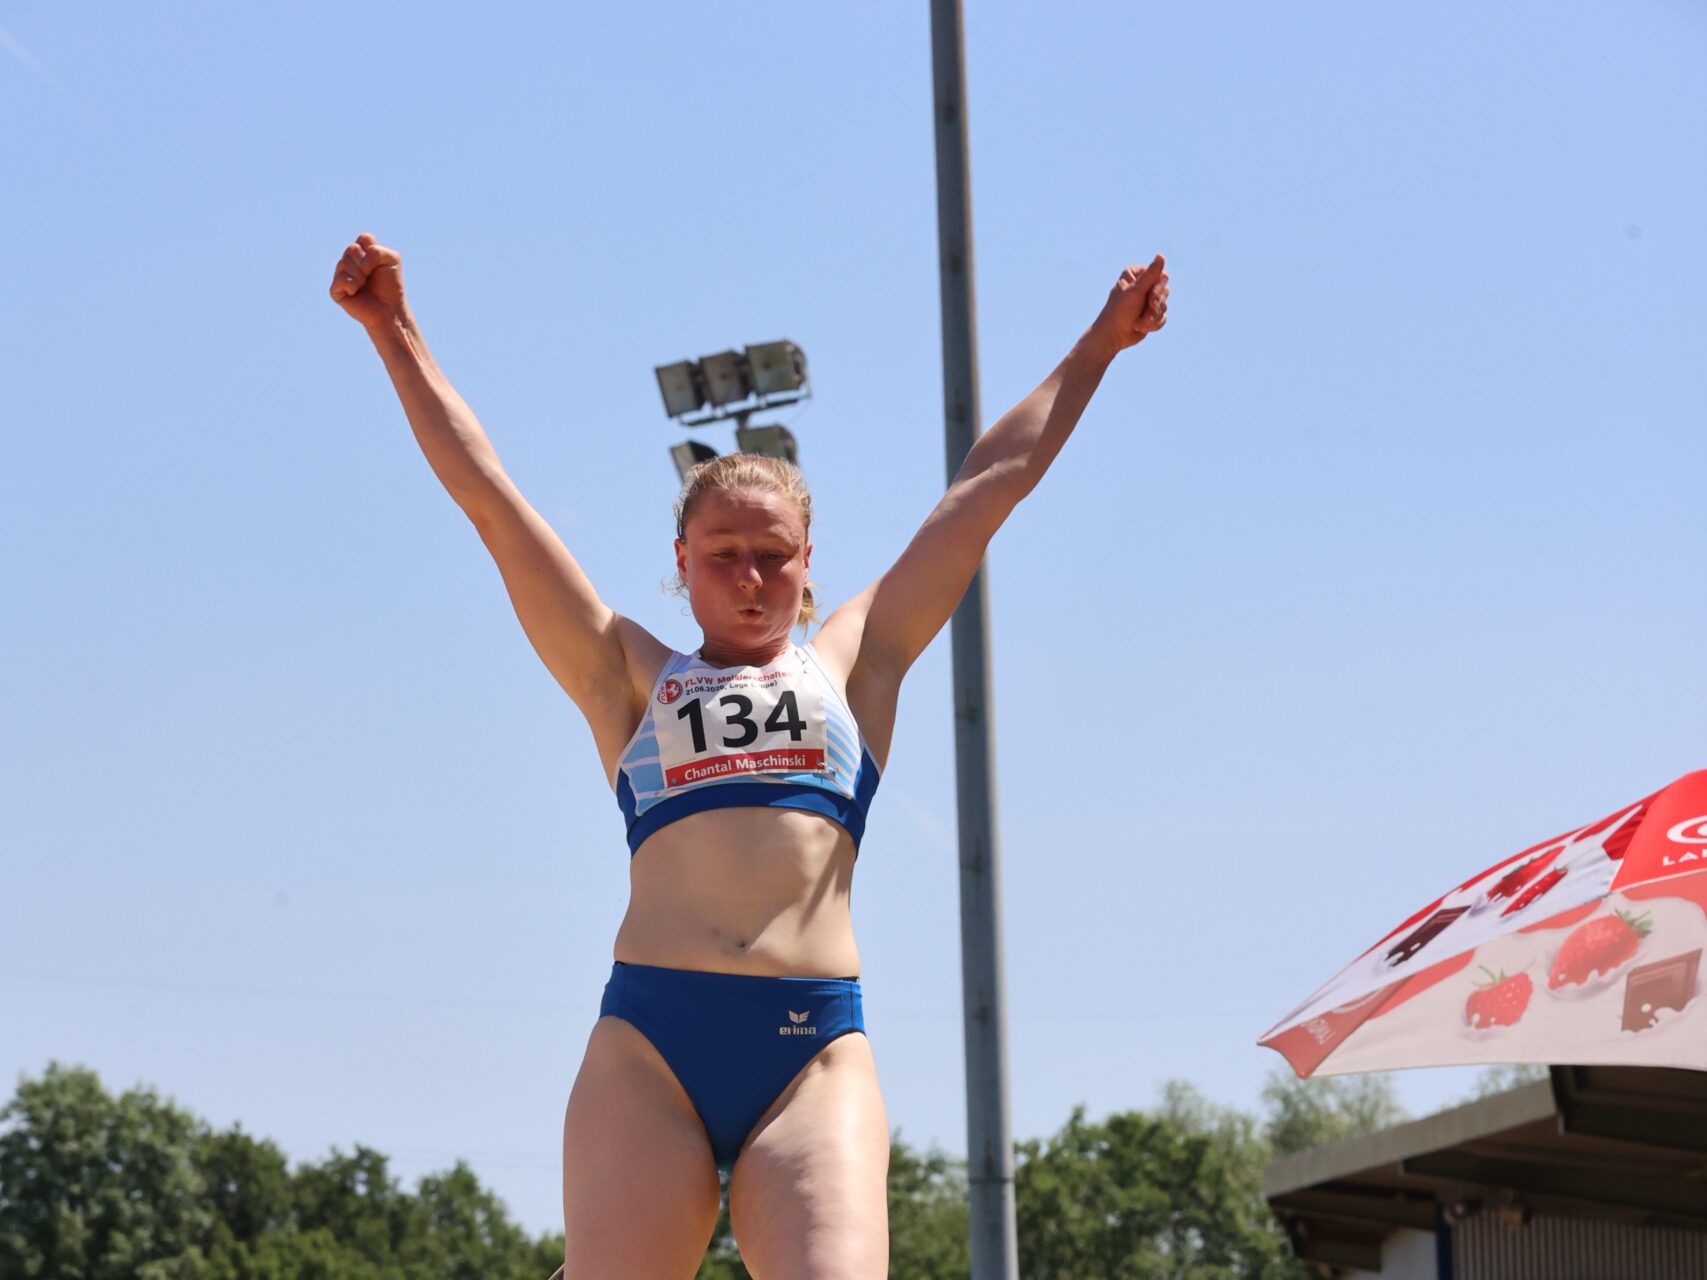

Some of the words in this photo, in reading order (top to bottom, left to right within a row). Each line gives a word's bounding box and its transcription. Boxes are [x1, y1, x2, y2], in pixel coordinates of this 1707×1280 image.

[685, 676, 713, 687] FLVW
[677, 690, 807, 753] 134
[685, 761, 732, 780] Chantal
[736, 755, 806, 769] Maschinski
[779, 1025, 817, 1035] erima
